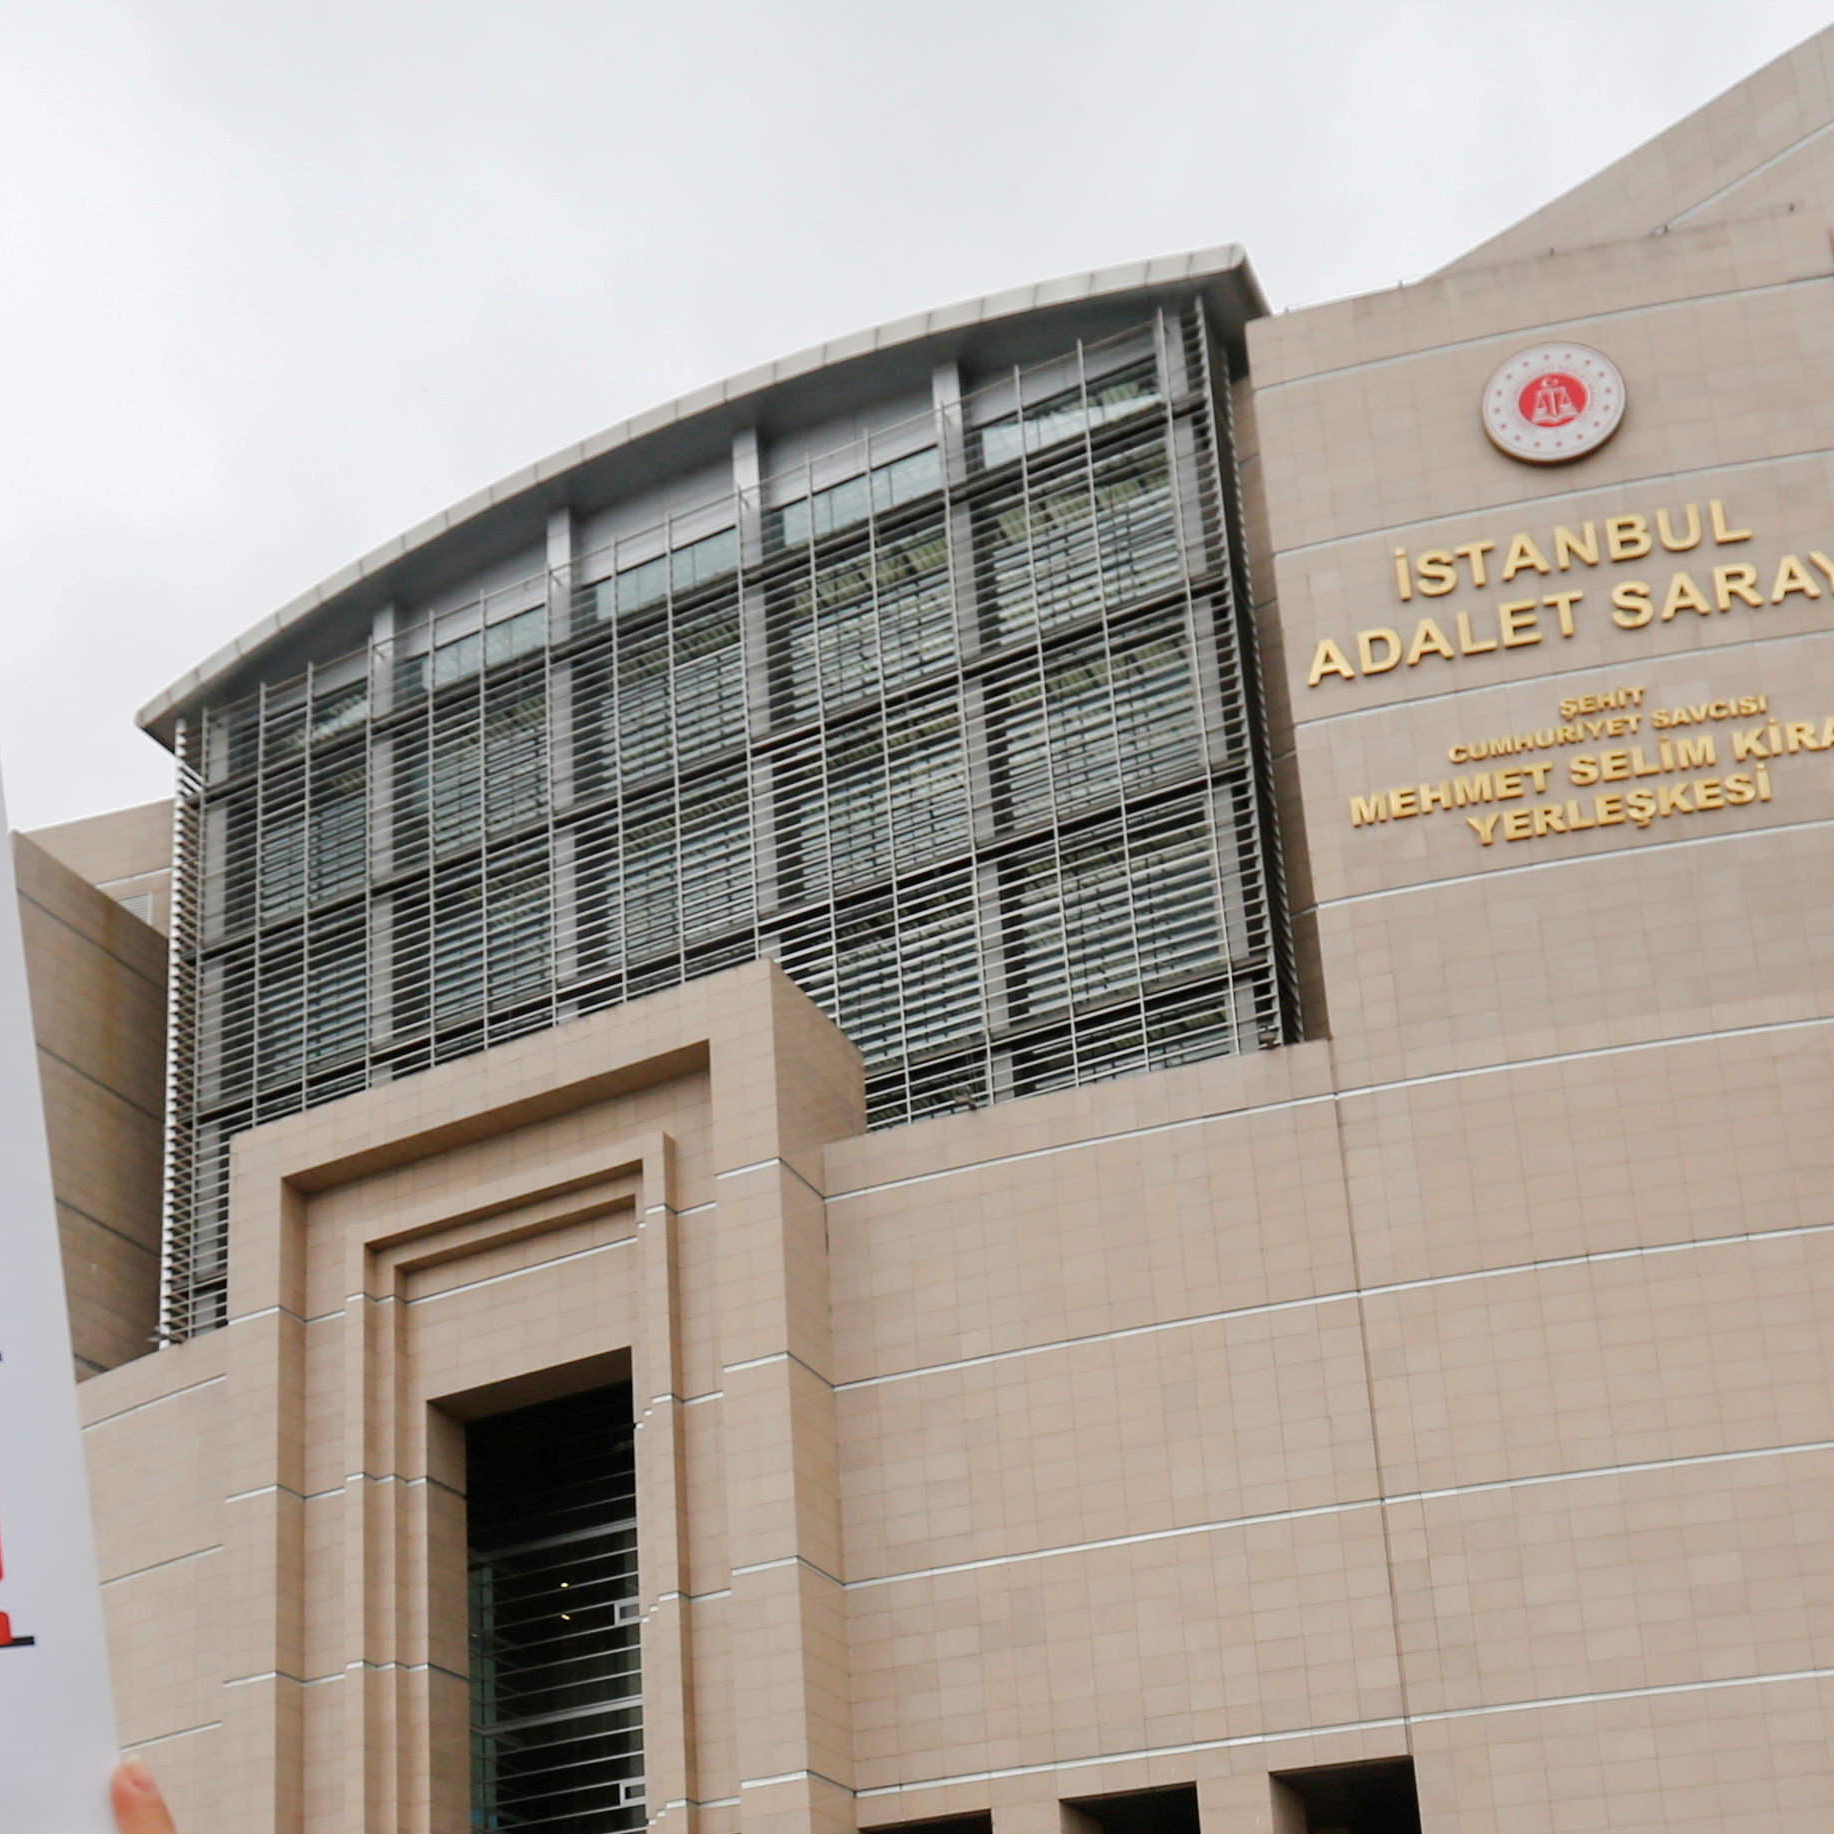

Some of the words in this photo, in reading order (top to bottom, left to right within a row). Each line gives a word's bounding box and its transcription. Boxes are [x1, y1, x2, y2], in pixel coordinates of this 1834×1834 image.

[1394, 499, 1753, 602] İSTANBUL
[1307, 590, 1584, 687] ADALET
[1449, 713, 1643, 764] CUMHURİYET
[1652, 694, 1768, 729] SAVCISI
[1560, 686, 1646, 721] ŞEHİT
[1351, 761, 1554, 829] MEHMET
[1569, 734, 1717, 787] SELİM
[1467, 763, 1773, 847] YERLEŞKESİ
